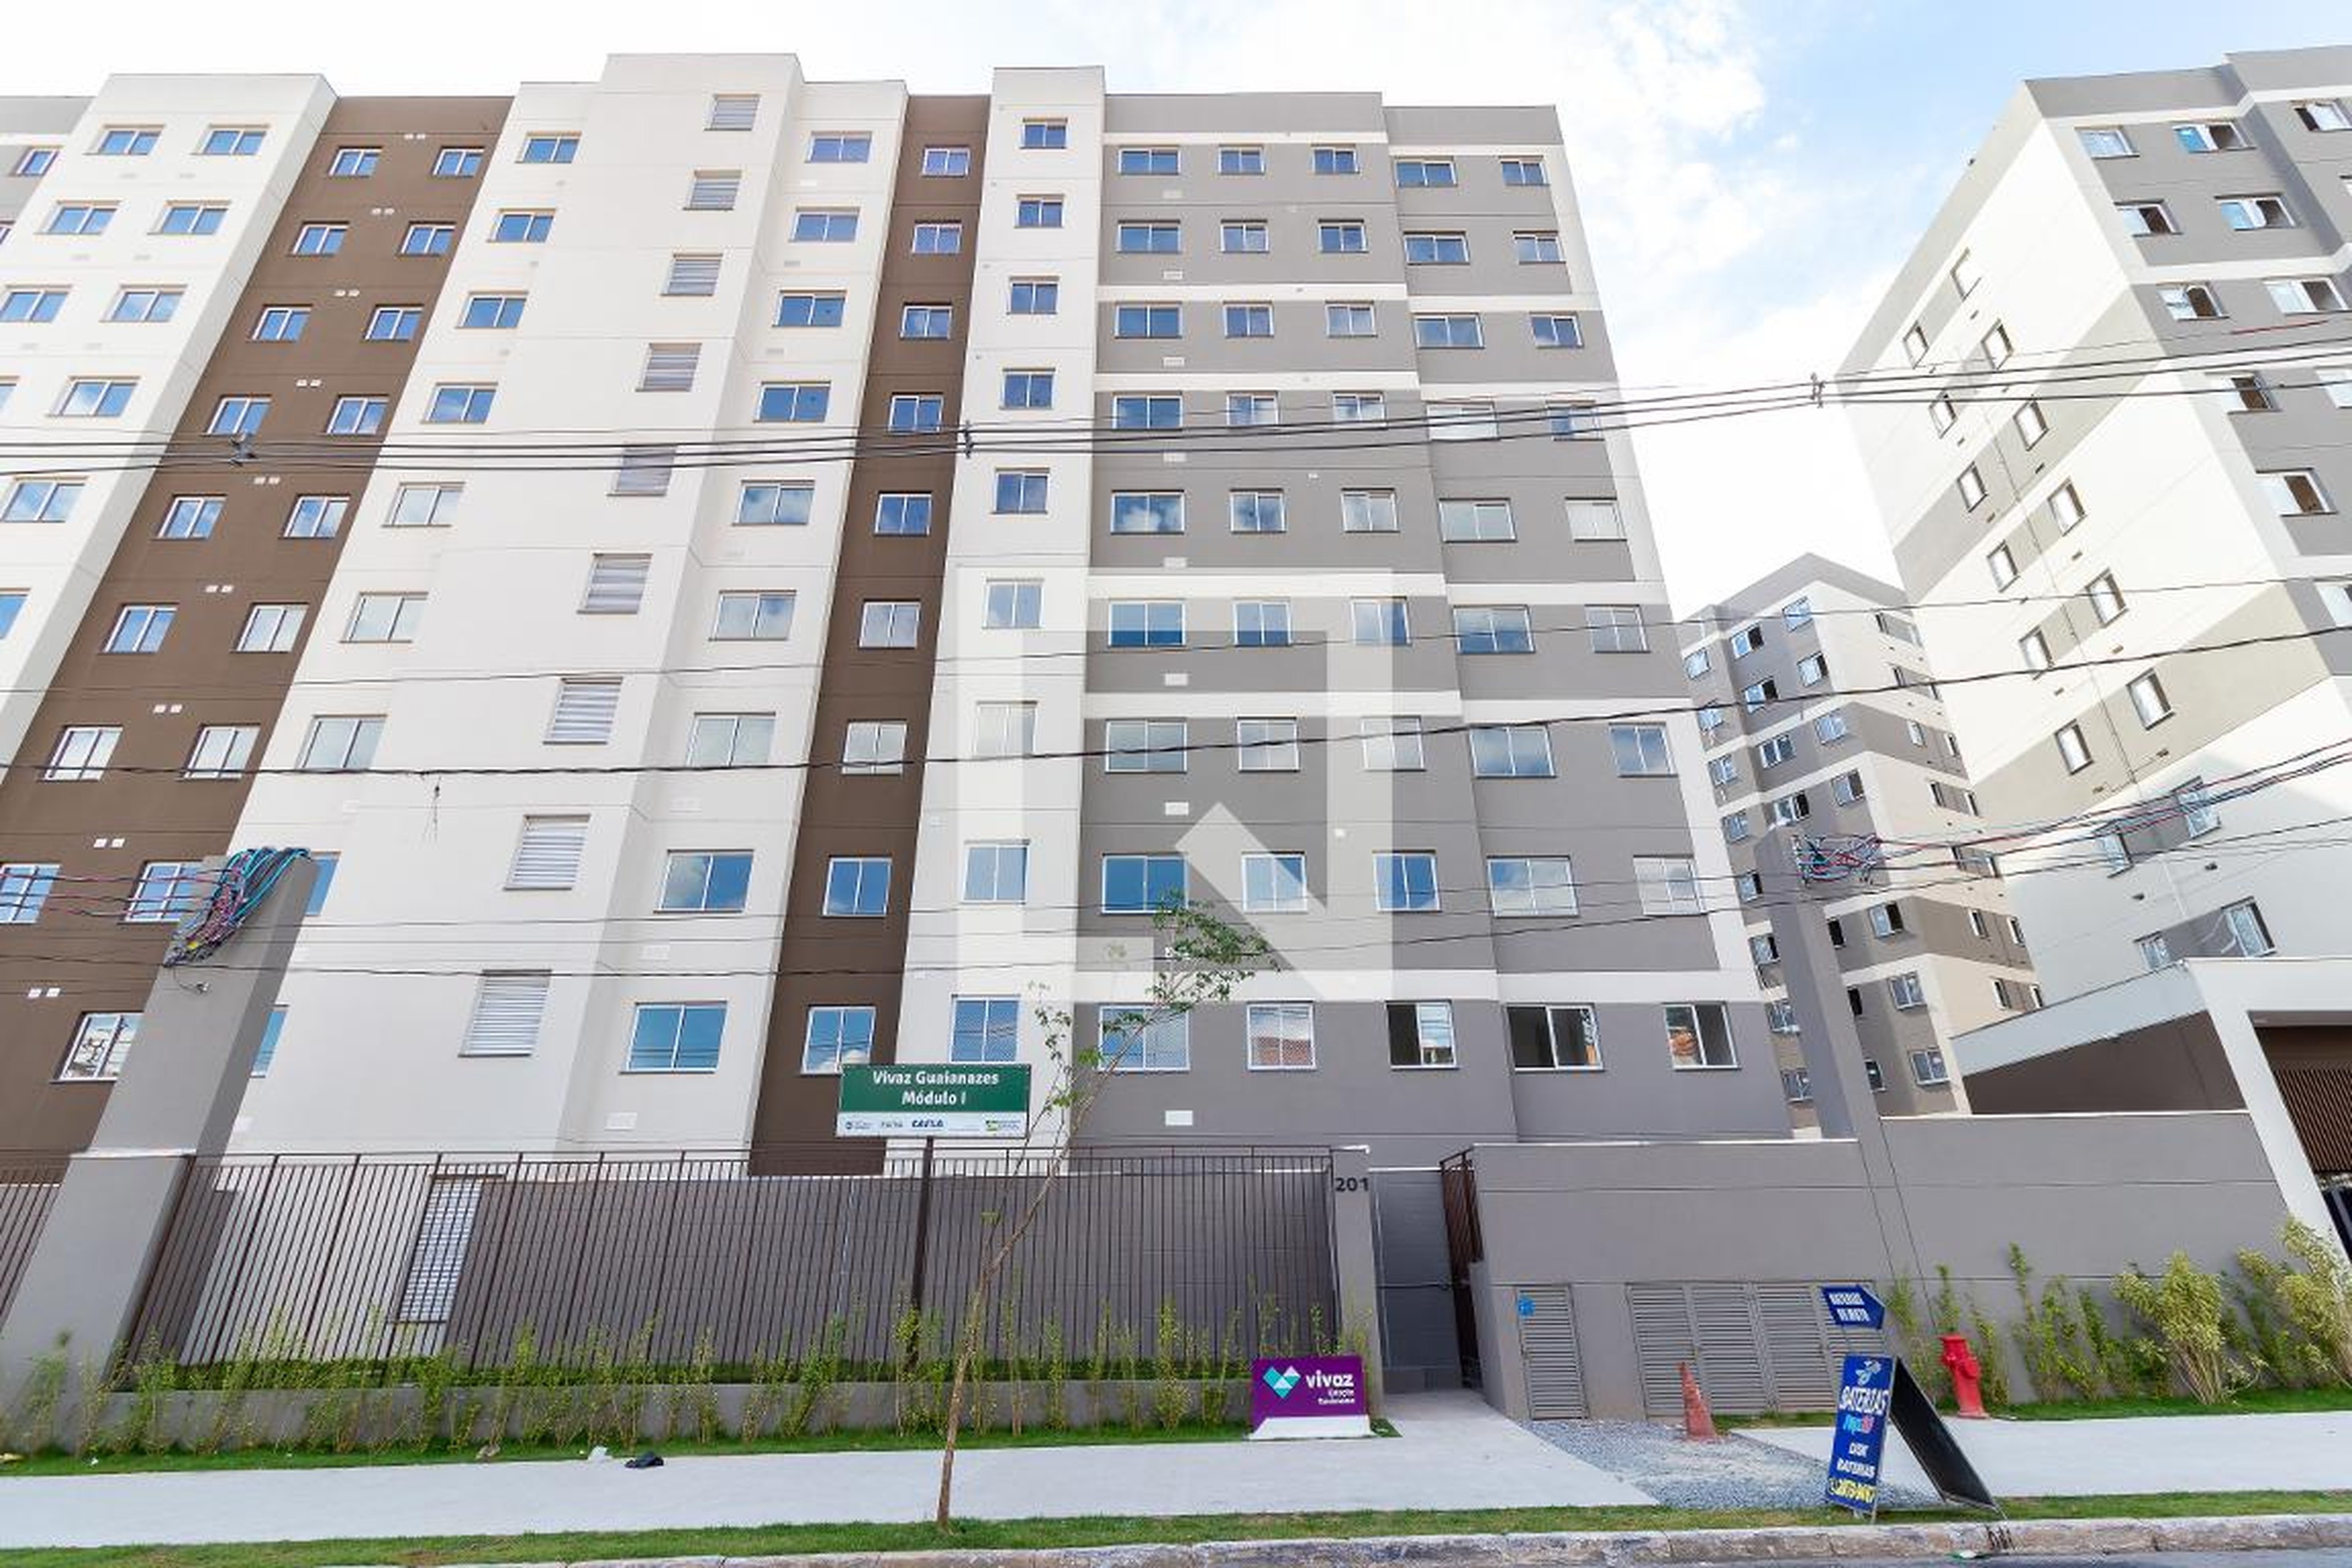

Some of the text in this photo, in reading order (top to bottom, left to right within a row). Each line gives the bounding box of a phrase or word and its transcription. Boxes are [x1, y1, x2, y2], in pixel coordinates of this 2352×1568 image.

[873, 1071, 1000, 1085] Vivaz Guaianazes
[902, 1089, 957, 1105] Módulo
[1335, 1177, 1368, 1192] 201
[1306, 1370, 1354, 1388] vivaz
